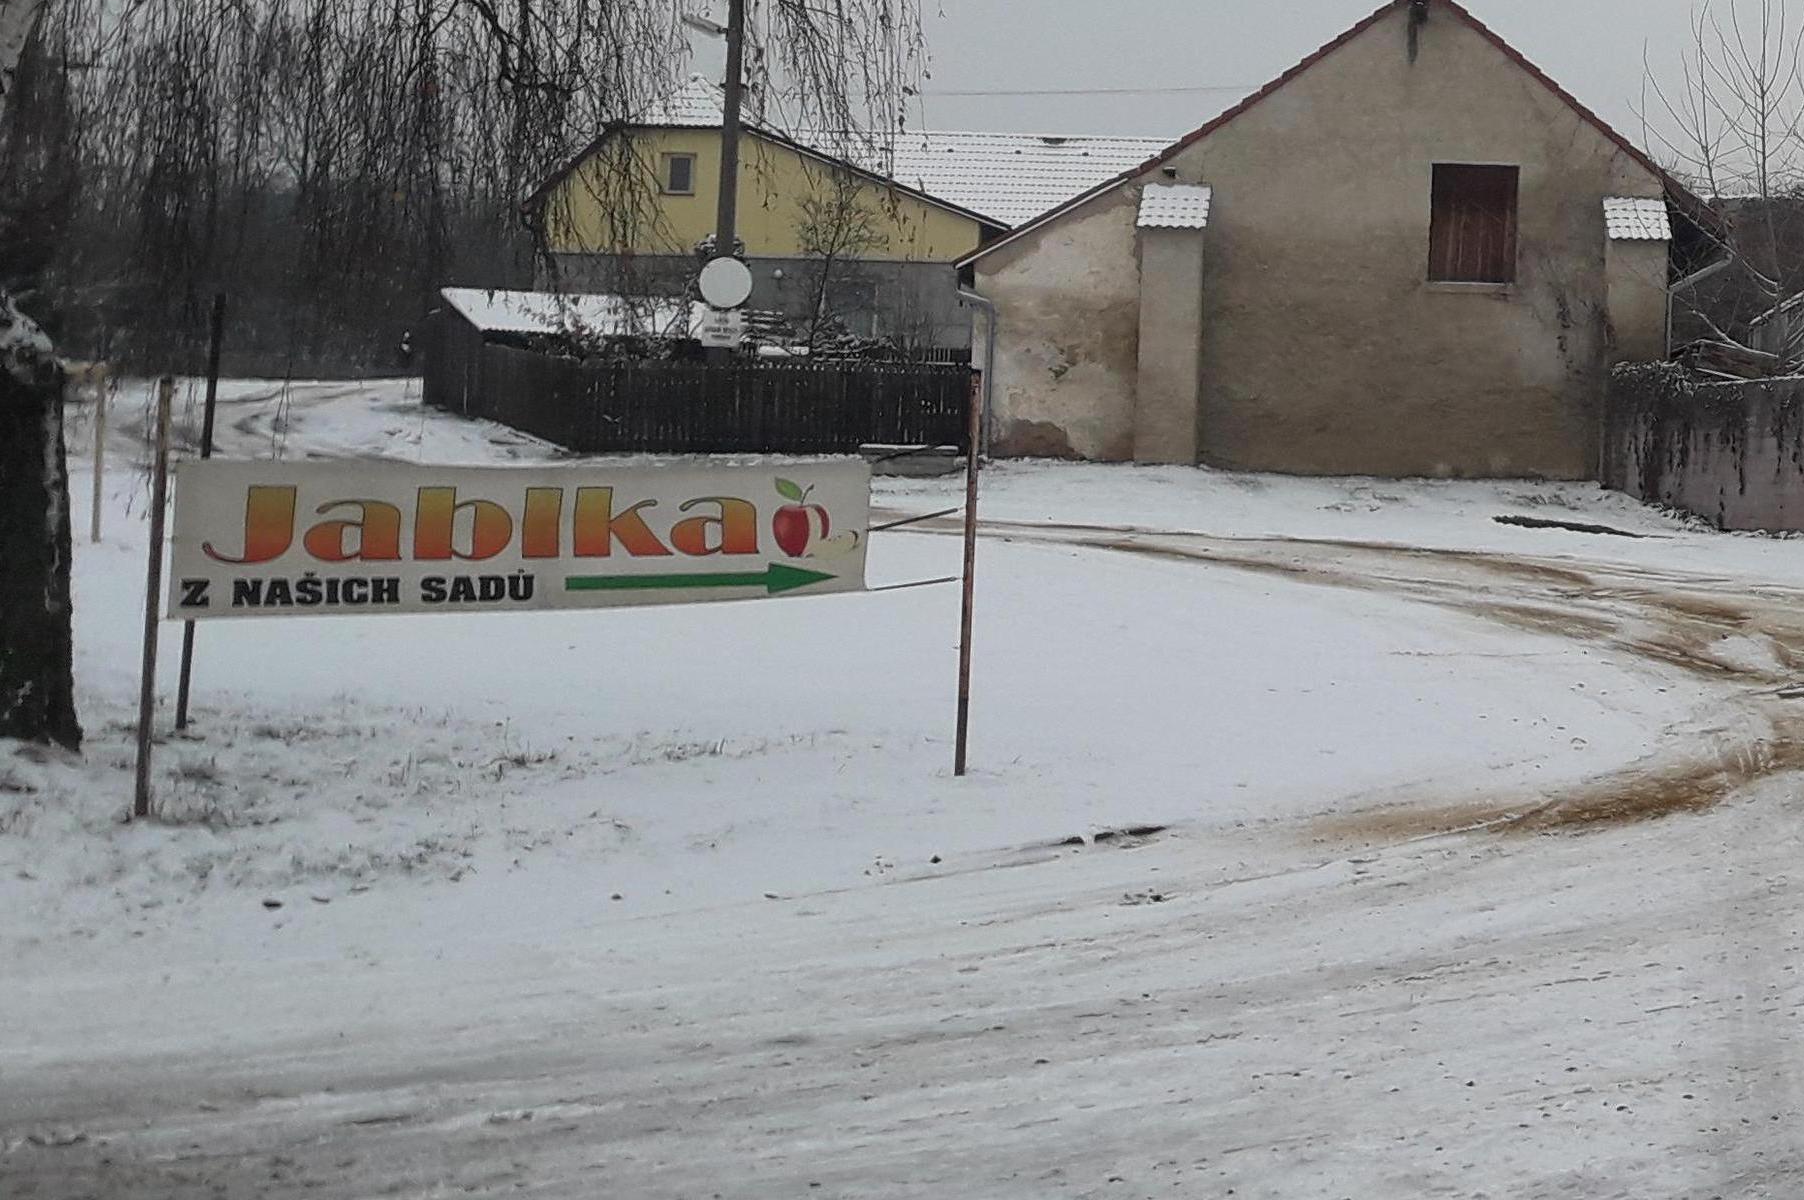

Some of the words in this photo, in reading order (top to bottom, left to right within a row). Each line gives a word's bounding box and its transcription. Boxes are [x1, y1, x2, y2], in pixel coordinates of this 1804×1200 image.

[201, 486, 760, 563] Jablka
[180, 579, 210, 607] Z
[232, 572, 400, 606] NAŠICH
[419, 569, 535, 602] SADŮ
